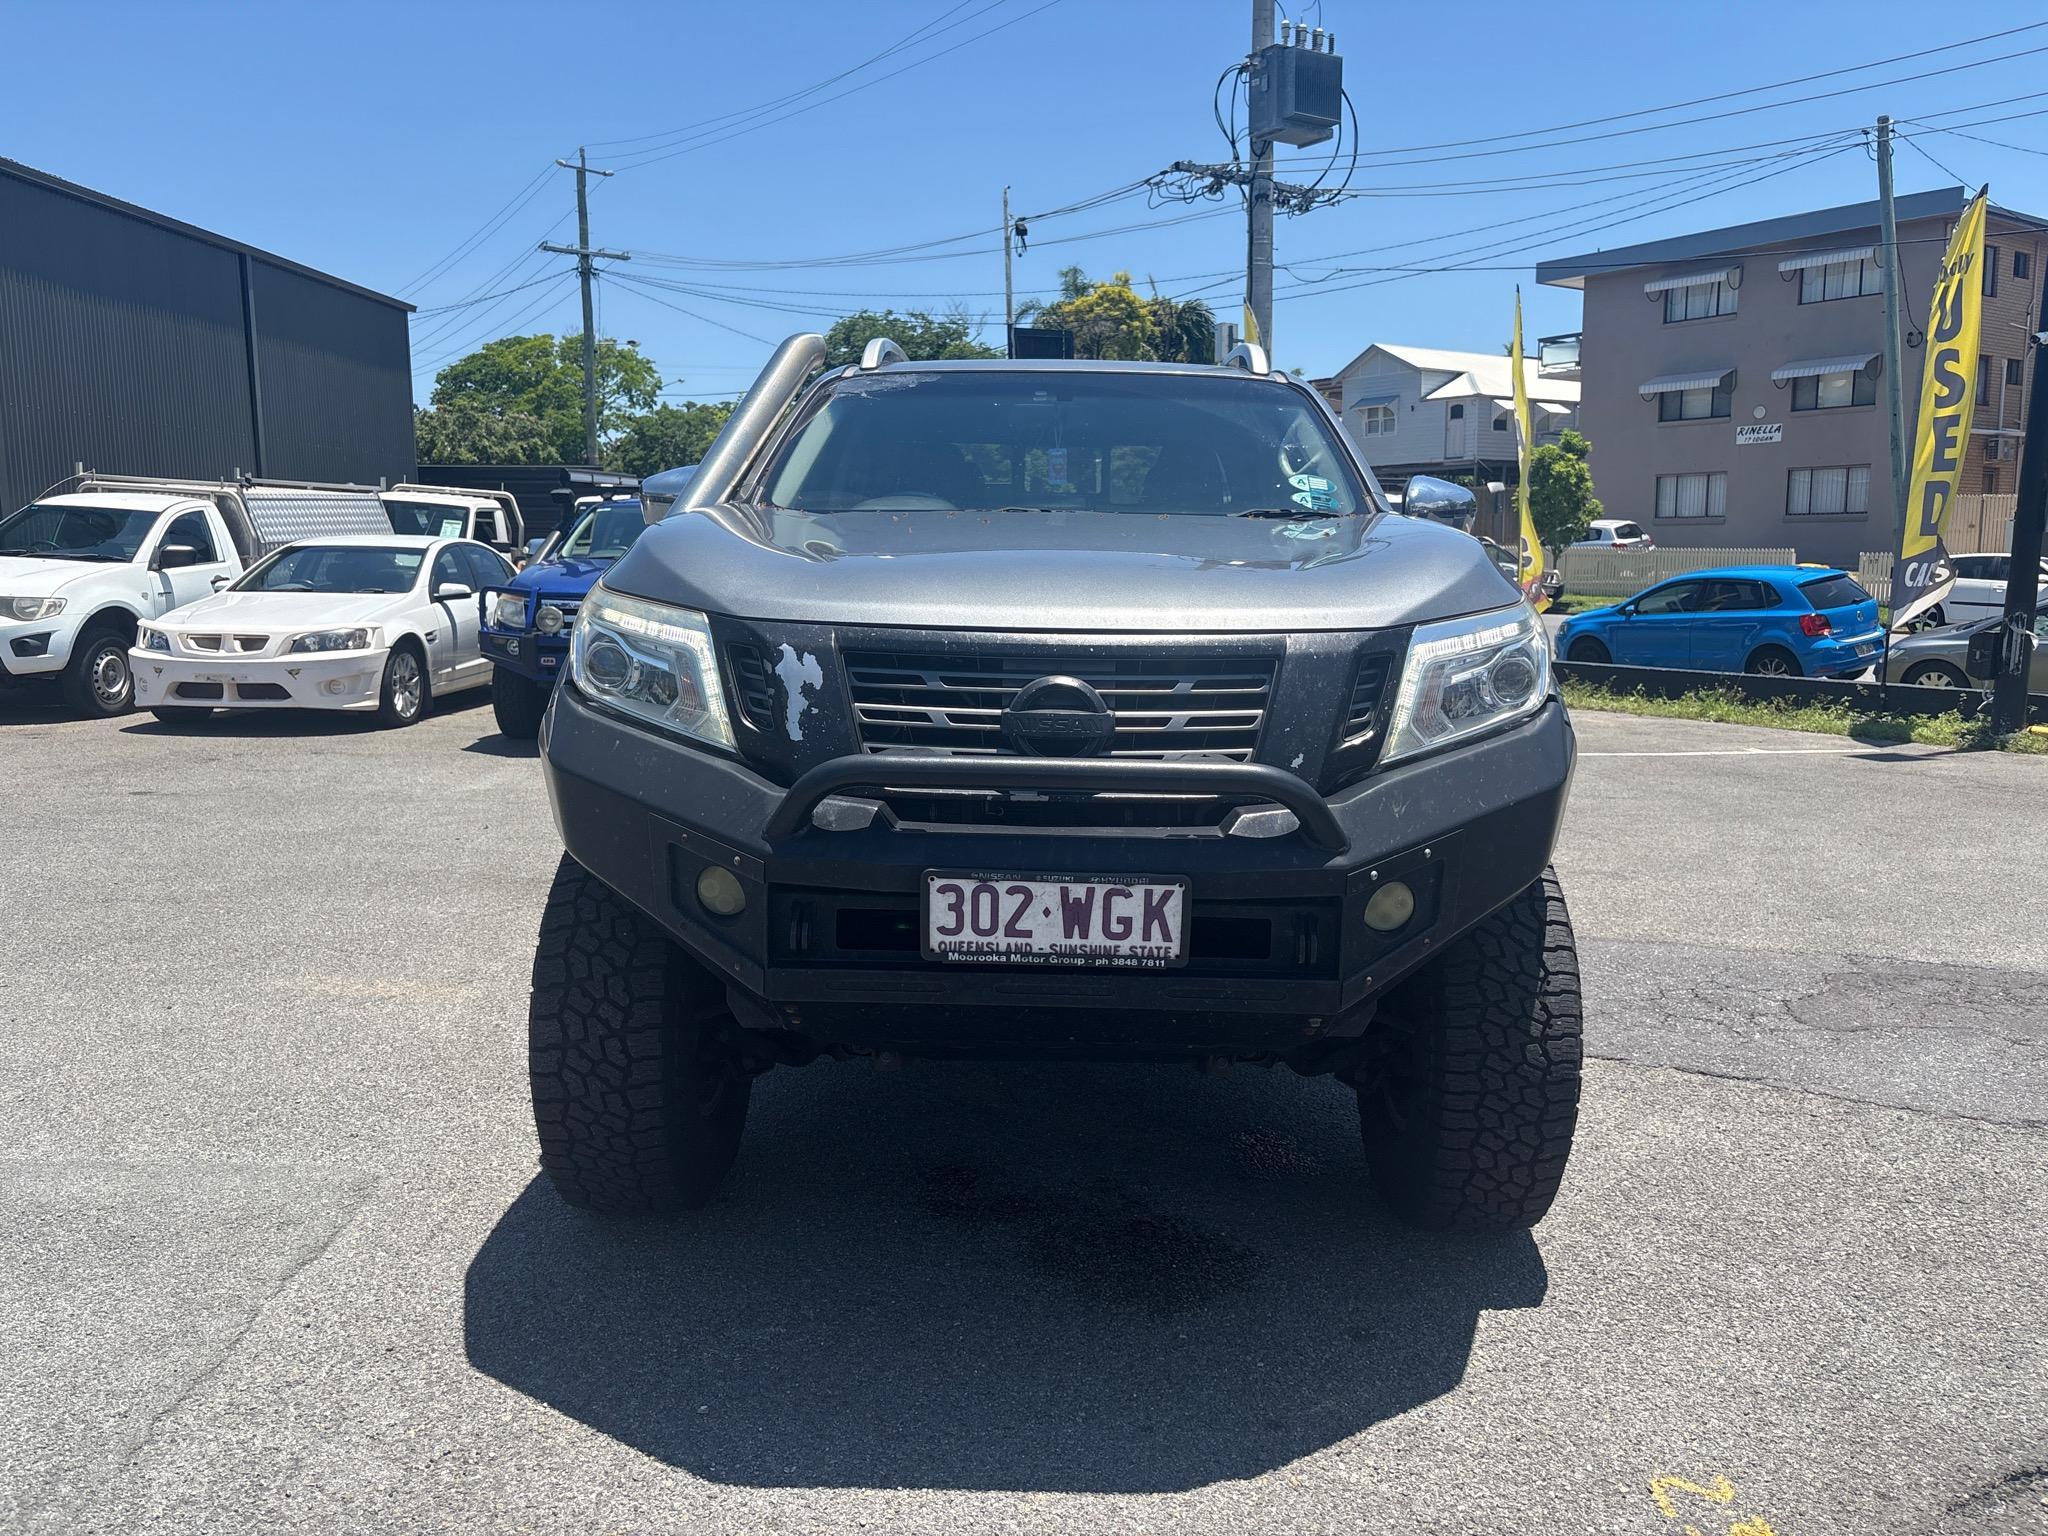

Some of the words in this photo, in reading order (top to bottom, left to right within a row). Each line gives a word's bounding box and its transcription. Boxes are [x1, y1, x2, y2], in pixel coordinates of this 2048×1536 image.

[1918, 274, 1967, 537] USED
[1737, 425, 1782, 436] RINELLA
[1042, 875, 1074, 883] SUZUKI
[938, 940, 1033, 952] QUEENSLAND
[1049, 943, 1121, 955] SUNSHINE
[1129, 945, 1172, 957] STATE
[948, 952, 1007, 962] Moorooka
[1010, 954, 1046, 963] Motor
[1049, 955, 1085, 966] Group
[1095, 957, 1108, 966] ph
[1111, 958, 1138, 966] 3848
[1141, 959, 1166, 967] 7811
